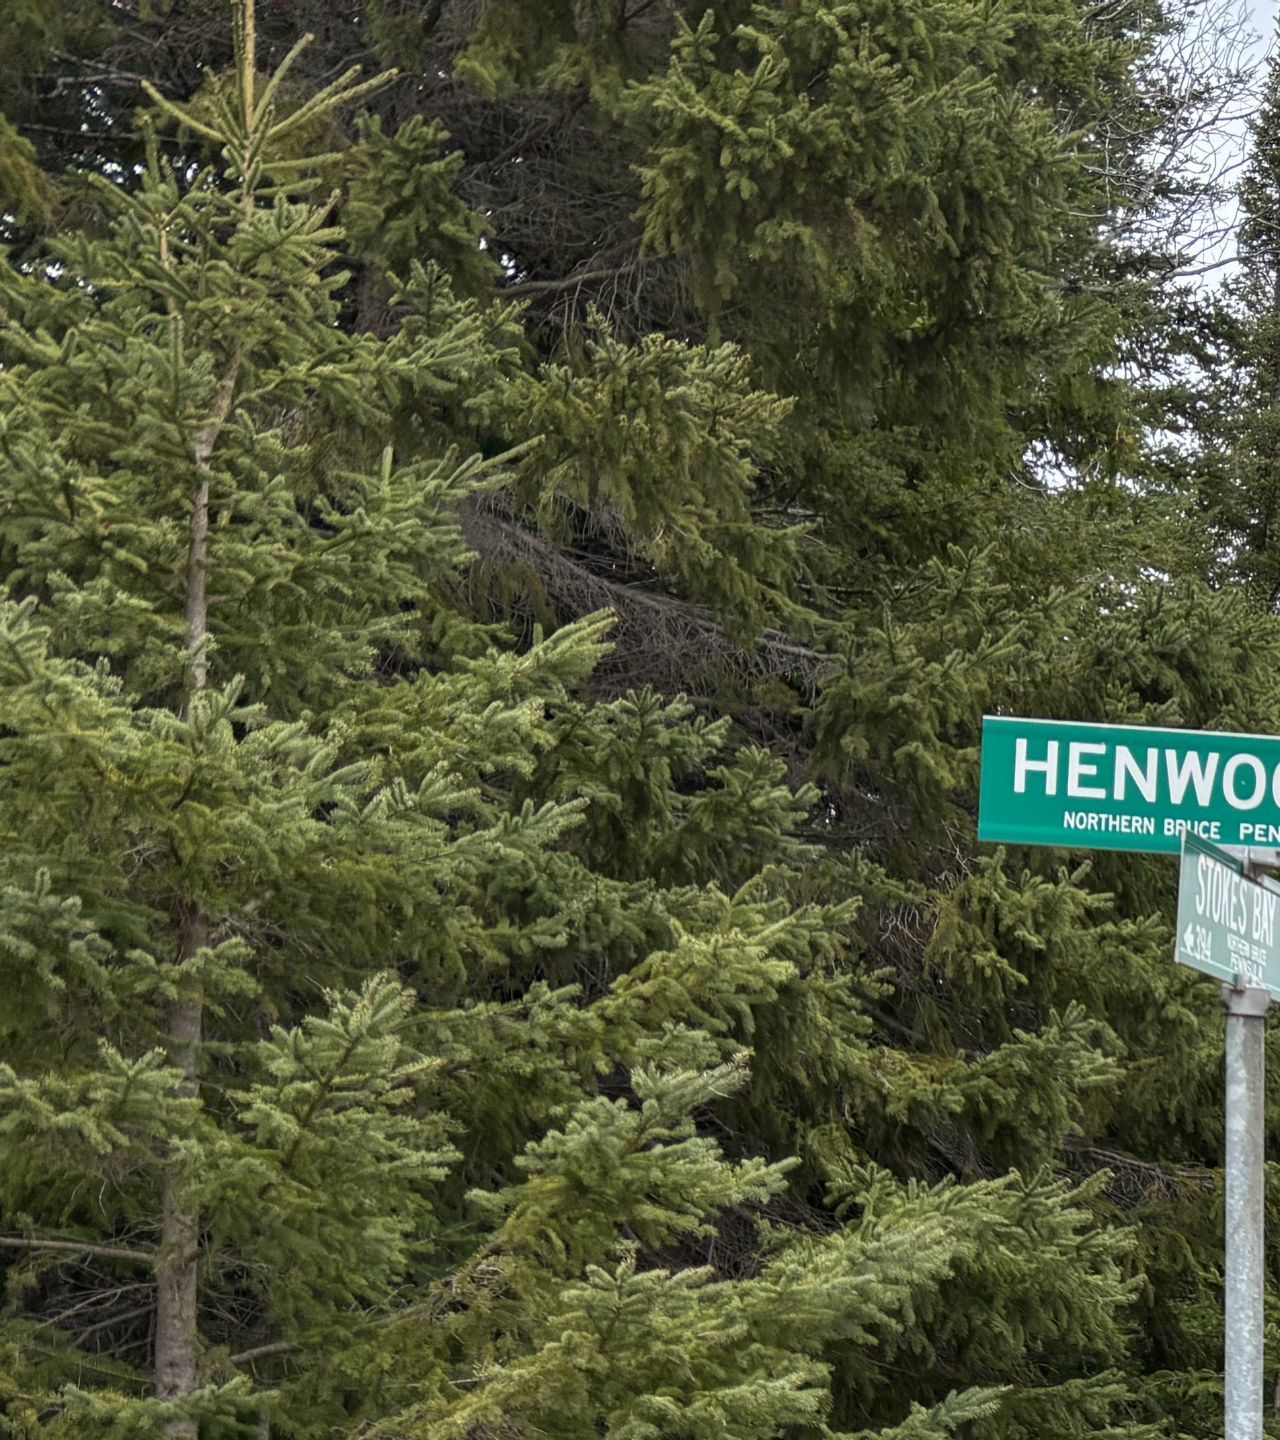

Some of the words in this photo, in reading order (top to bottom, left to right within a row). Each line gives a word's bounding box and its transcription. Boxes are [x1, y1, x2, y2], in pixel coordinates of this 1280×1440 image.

[1063, 811, 1155, 835] NORTHERN
[1195, 853, 1248, 936] STOKES
[1252, 886, 1277, 948] BAY
